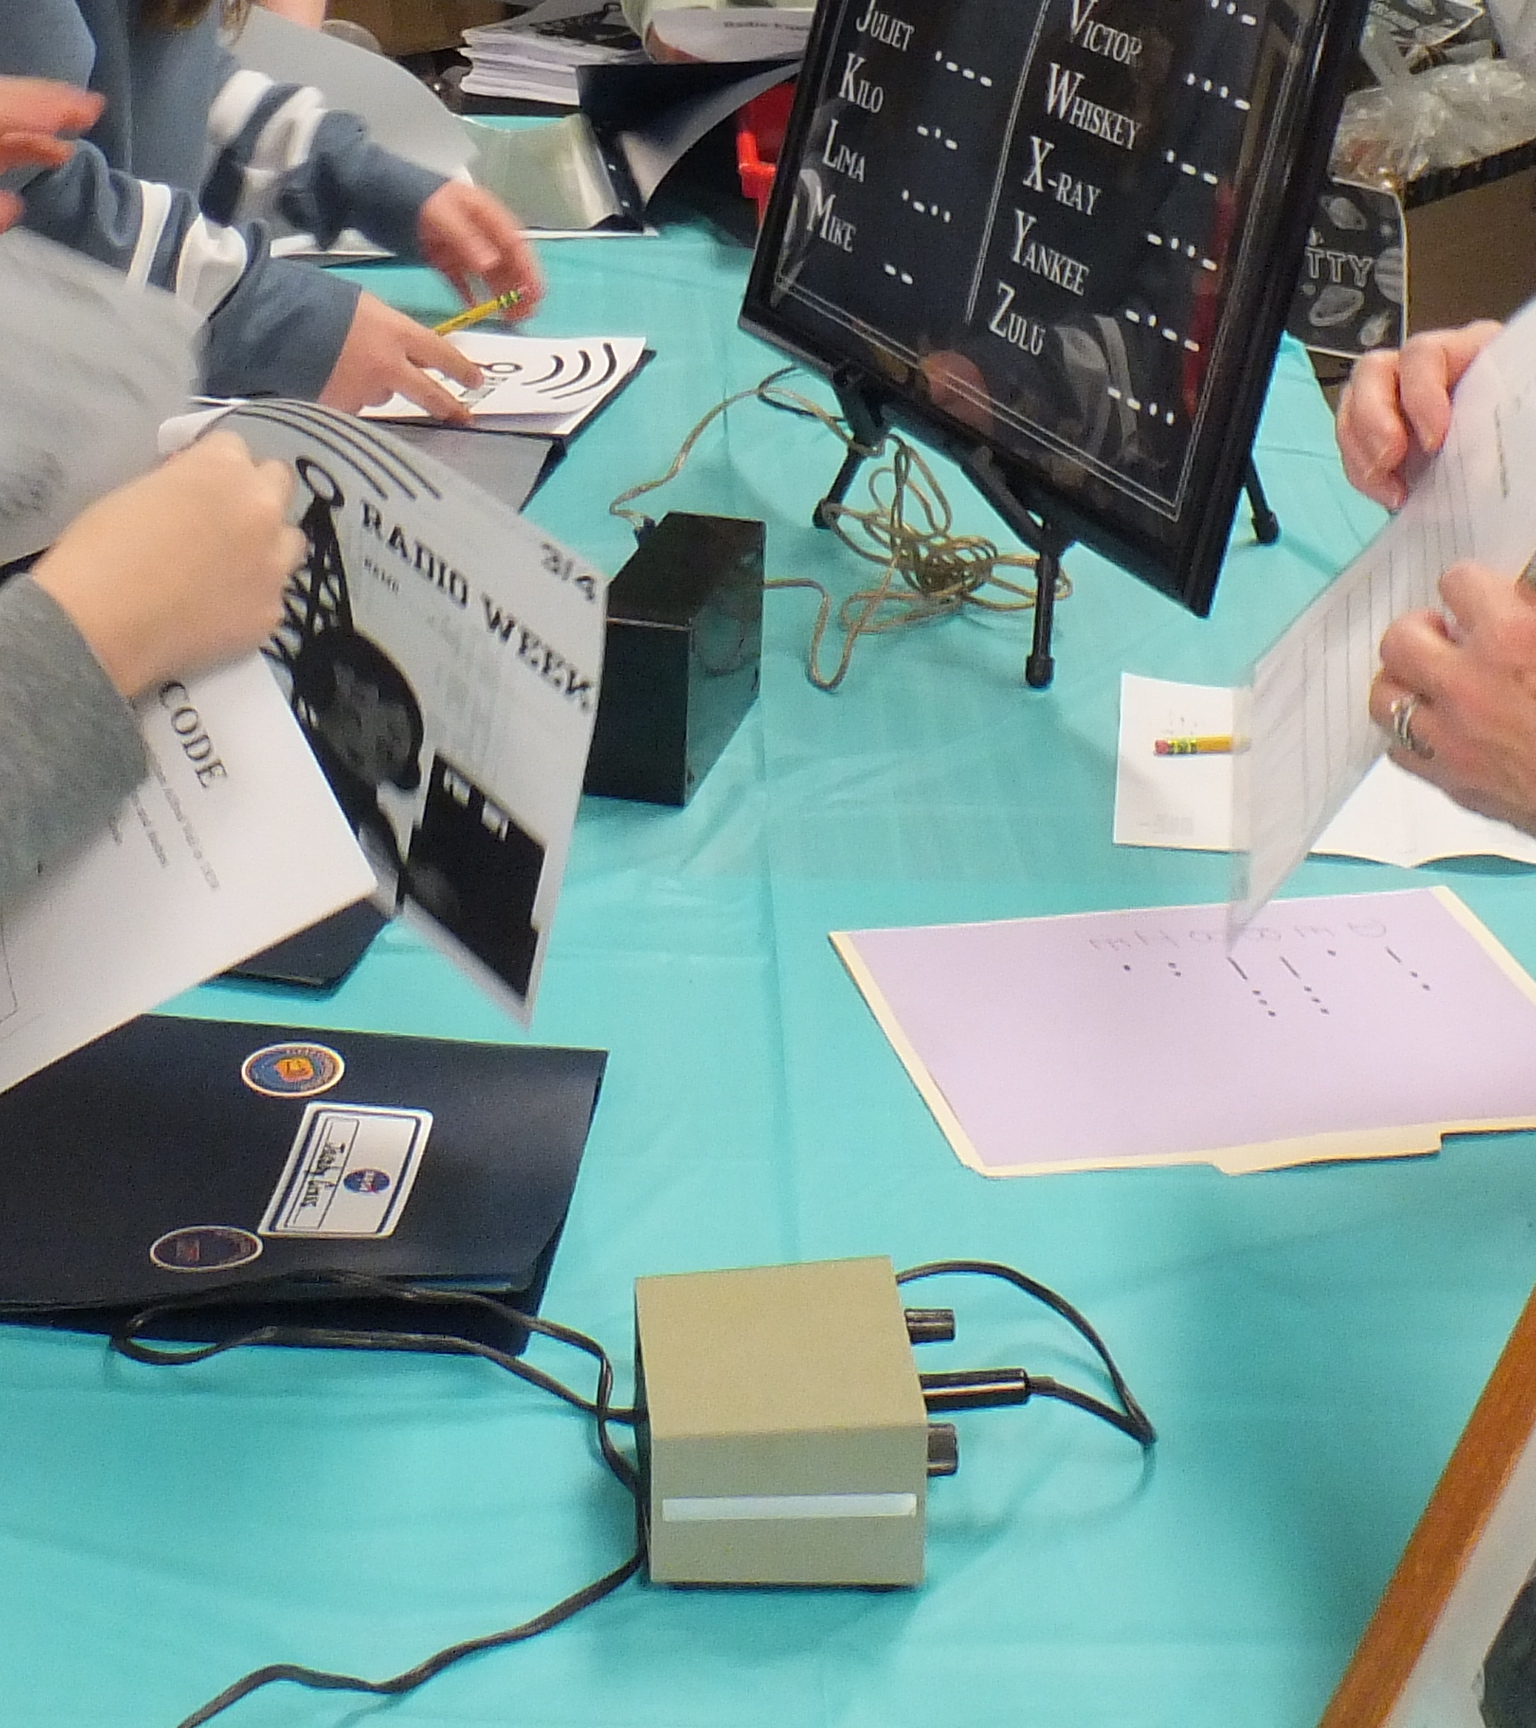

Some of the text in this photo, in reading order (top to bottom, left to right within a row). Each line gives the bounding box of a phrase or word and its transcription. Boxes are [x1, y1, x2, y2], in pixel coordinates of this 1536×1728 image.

[837, 51, 884, 114] KILO
[1041, 61, 1142, 152] WHISKEY
[820, 118, 865, 184] LIMA
[1022, 135, 1102, 217] X-RAY
[804, 183, 857, 254] MIKE
[1010, 208, 1091, 297] YANKEE
[986, 281, 1047, 356] ZULU
[359, 497, 593, 714] RADIO WEEK
[159, 678, 228, 790] CODE
